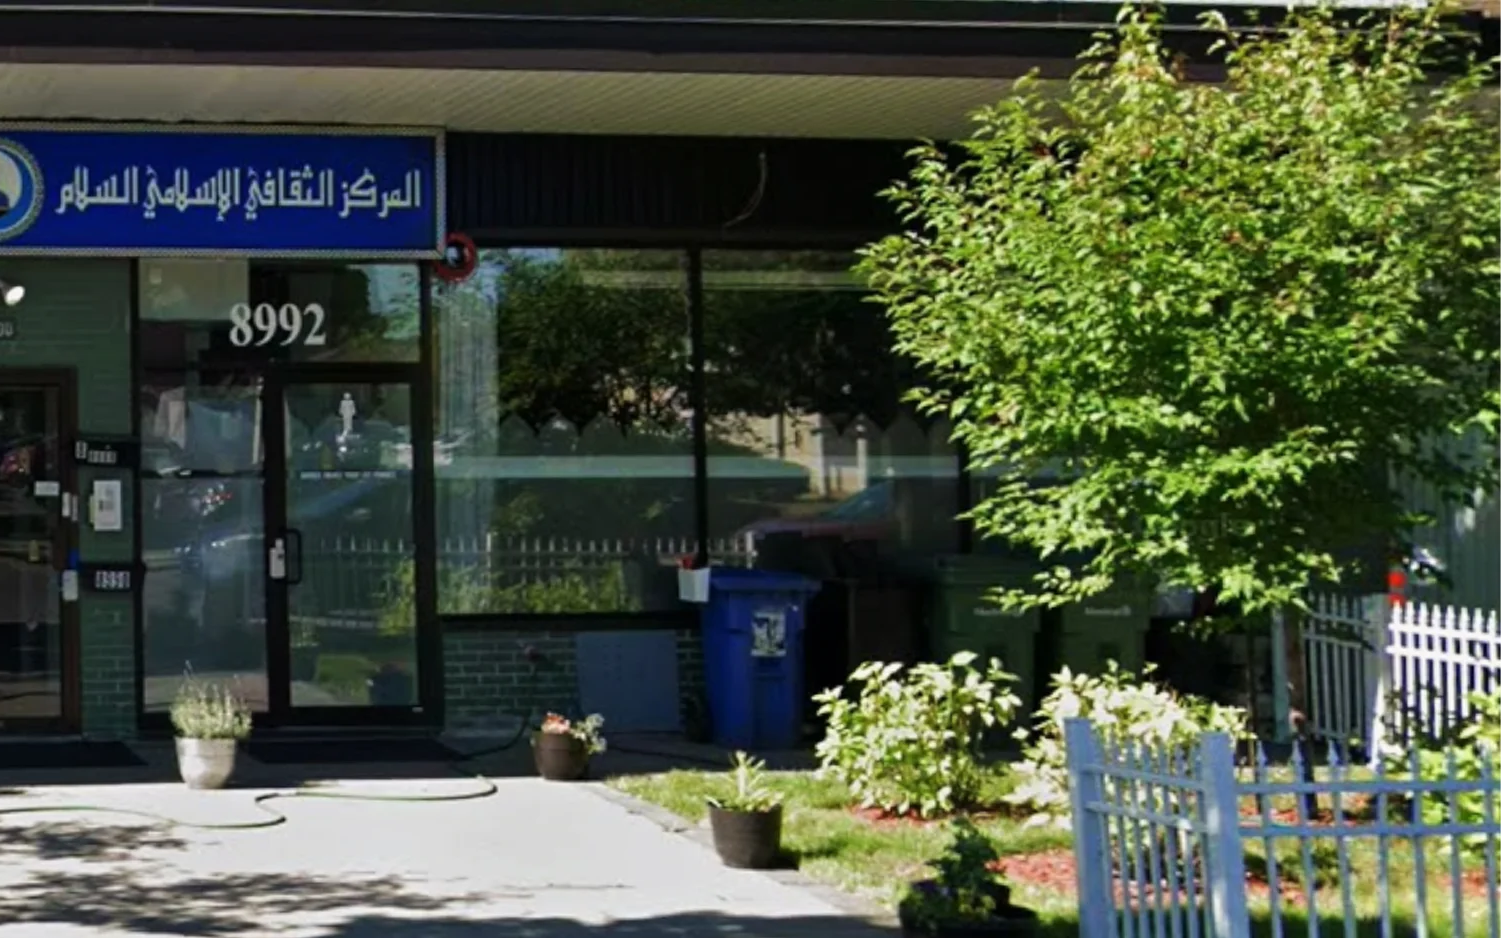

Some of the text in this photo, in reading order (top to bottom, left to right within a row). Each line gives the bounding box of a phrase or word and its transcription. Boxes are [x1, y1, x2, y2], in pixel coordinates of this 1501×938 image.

[55, 163, 422, 222] المركز الثقافي الإسلامي السلام
[228, 302, 327, 347] 8992
